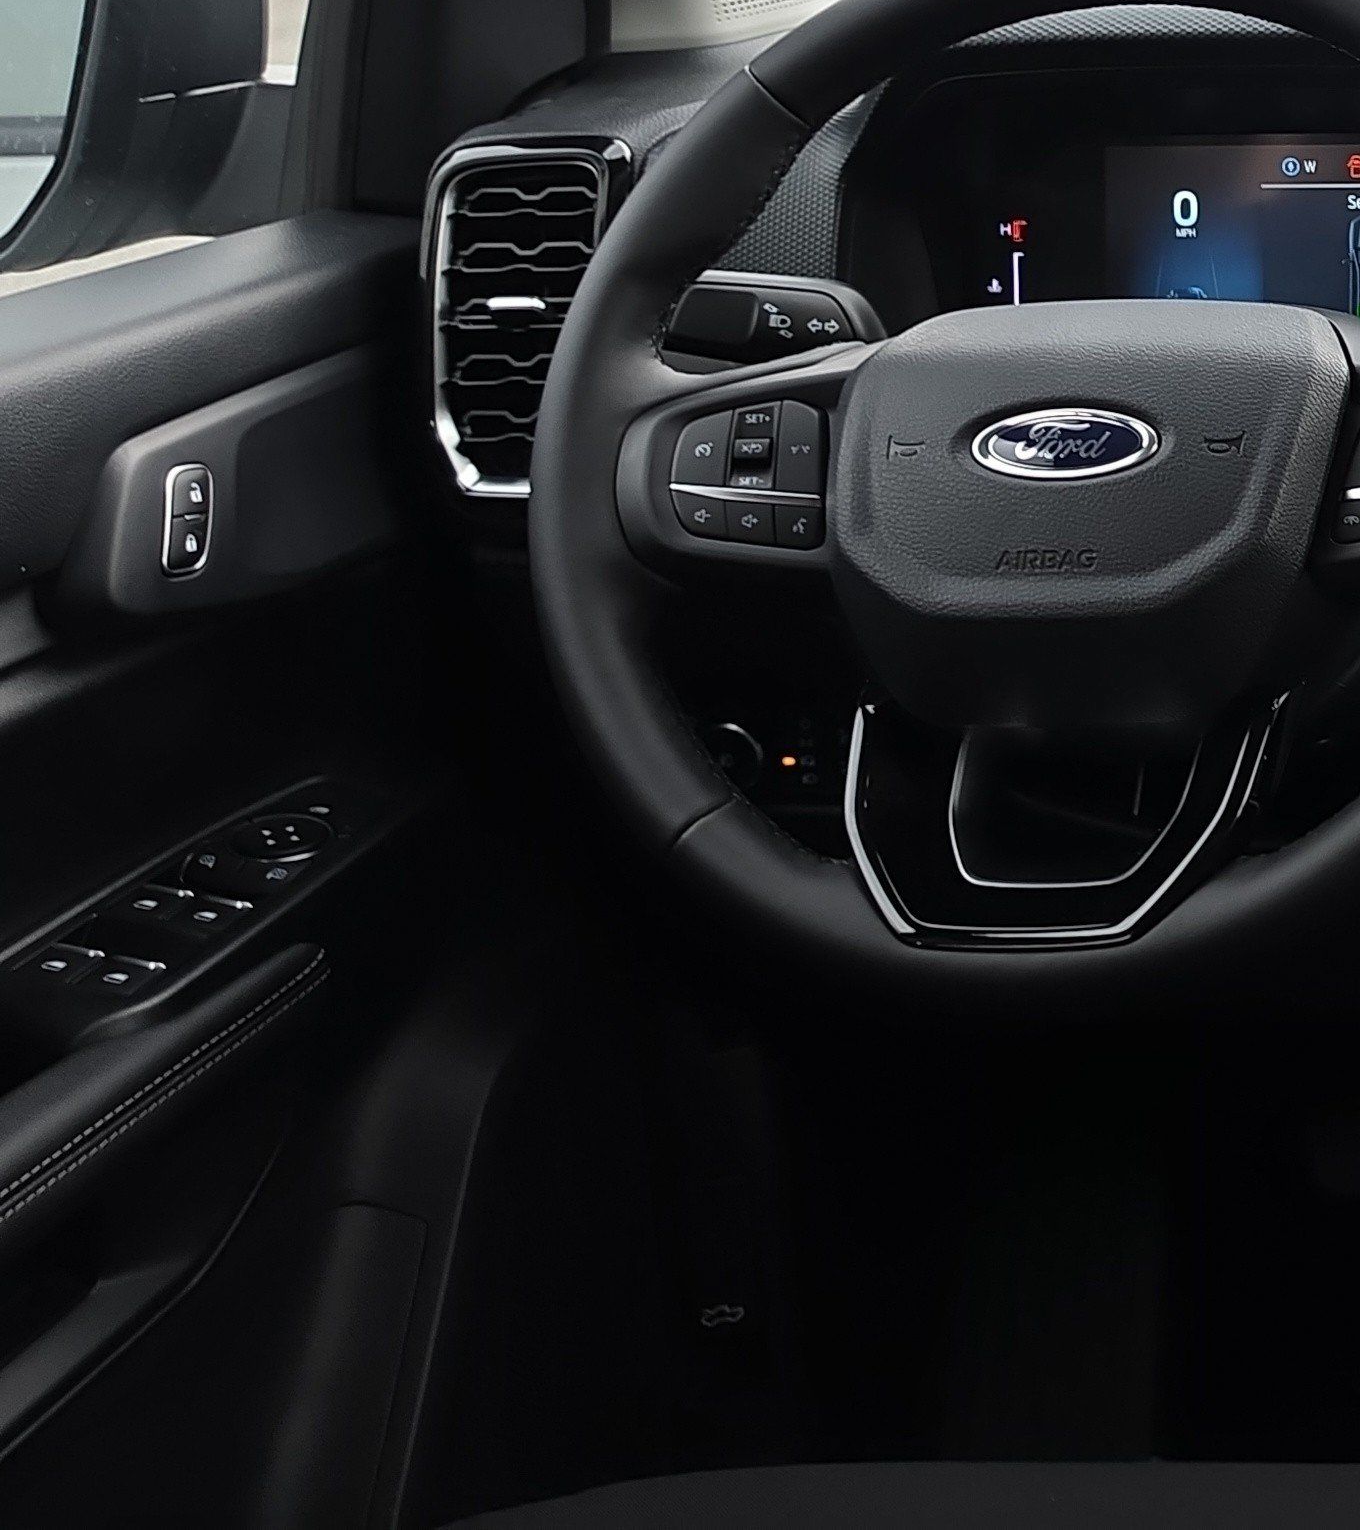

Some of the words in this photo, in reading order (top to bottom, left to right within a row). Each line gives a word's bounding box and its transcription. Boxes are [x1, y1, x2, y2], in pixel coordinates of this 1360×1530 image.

[1303, 159, 1318, 174] W
[1172, 189, 1199, 227] 0
[999, 222, 1012, 236] H
[1175, 227, 1197, 238] MPH
[744, 413, 771, 424] SET+
[1014, 421, 1112, 459] Ford
[995, 548, 1099, 573] AIRBAG
